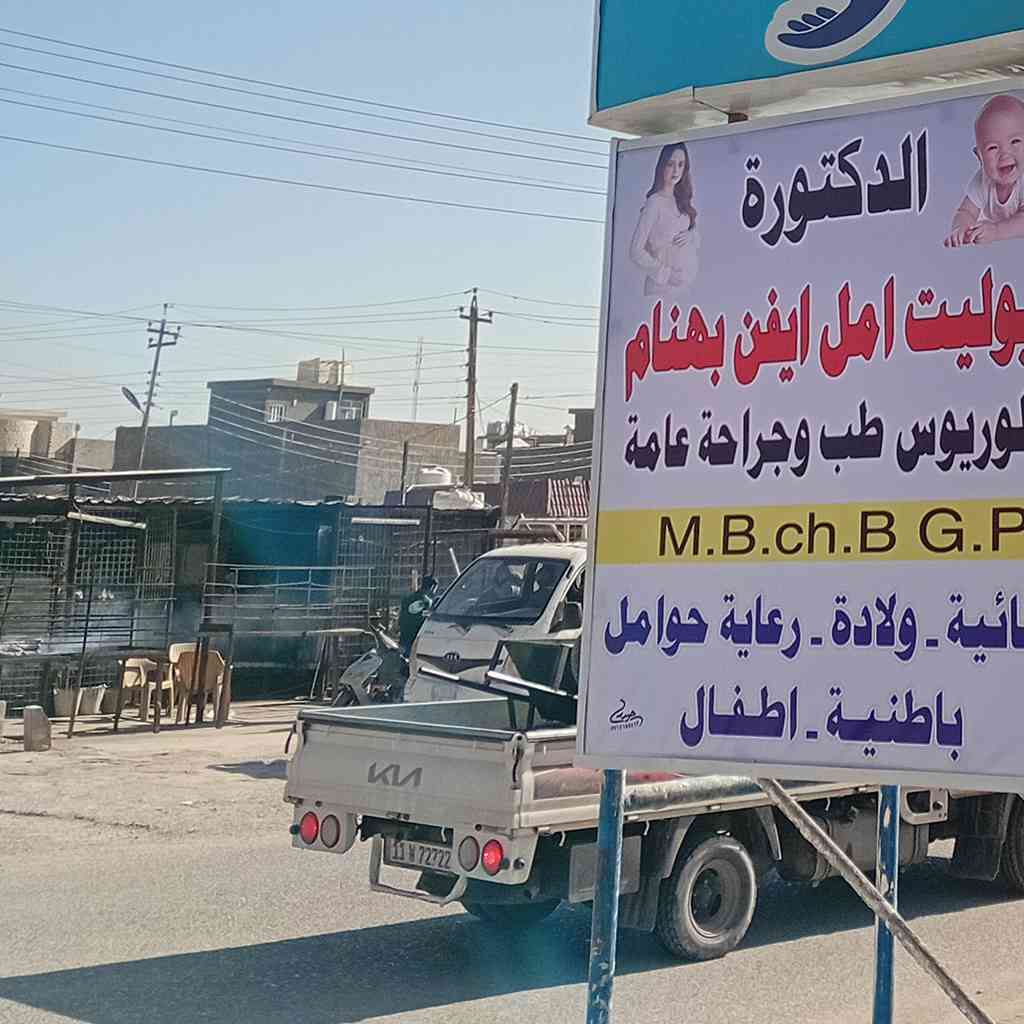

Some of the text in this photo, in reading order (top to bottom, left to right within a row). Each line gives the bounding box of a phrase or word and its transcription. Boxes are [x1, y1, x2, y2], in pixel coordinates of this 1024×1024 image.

[741, 128, 928, 247] الدكتورة
[625, 300, 726, 402] بهنام
[733, 282, 811, 385] ايفن
[819, 275, 896, 378] امل
[624, 412, 689, 471] عامة
[699, 406, 810, 479] وجراحة
[820, 400, 884, 473] طب
[657, 509, 897, 557] M.B.ch.B
[604, 593, 709, 657] حوامل
[719, 593, 801, 660] رعاية
[832, 592, 917, 661] ولادة
[679, 683, 798, 748] اطفال
[826, 684, 964, 761] باطنية
[368, 761, 423, 787] KIA
